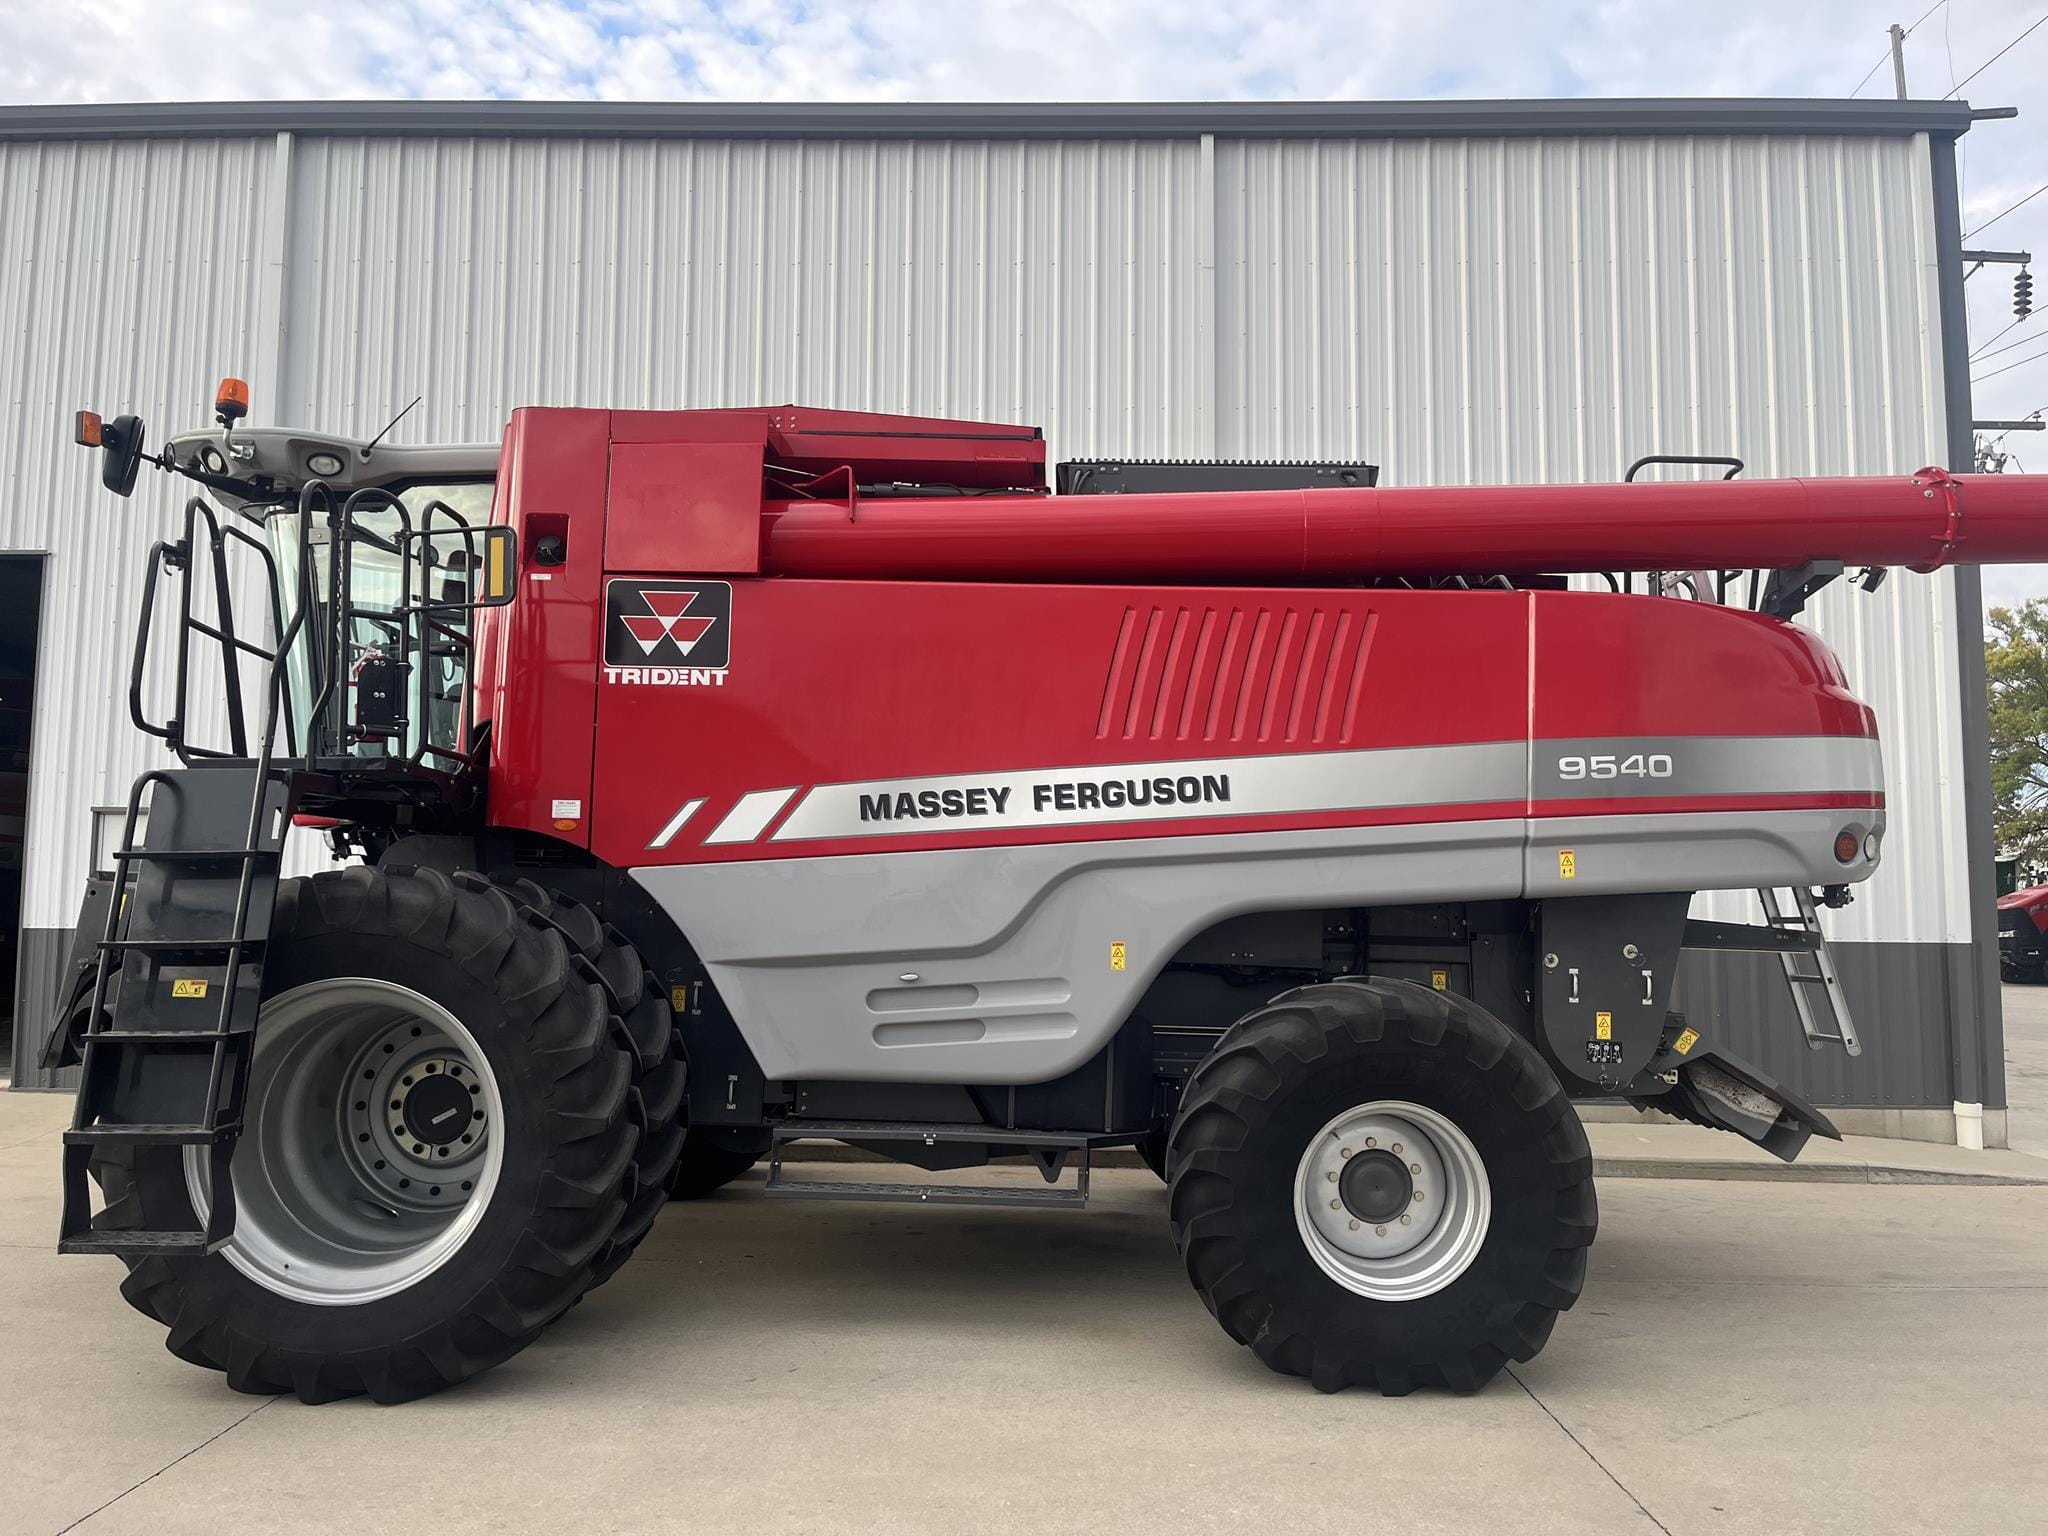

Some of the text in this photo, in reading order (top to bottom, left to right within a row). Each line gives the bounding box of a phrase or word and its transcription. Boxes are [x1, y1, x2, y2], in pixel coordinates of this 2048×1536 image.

[603, 668, 729, 686] TRIDENT
[1558, 754, 1673, 780] 9540
[860, 774, 1232, 821] MASSEY FERGUSON
